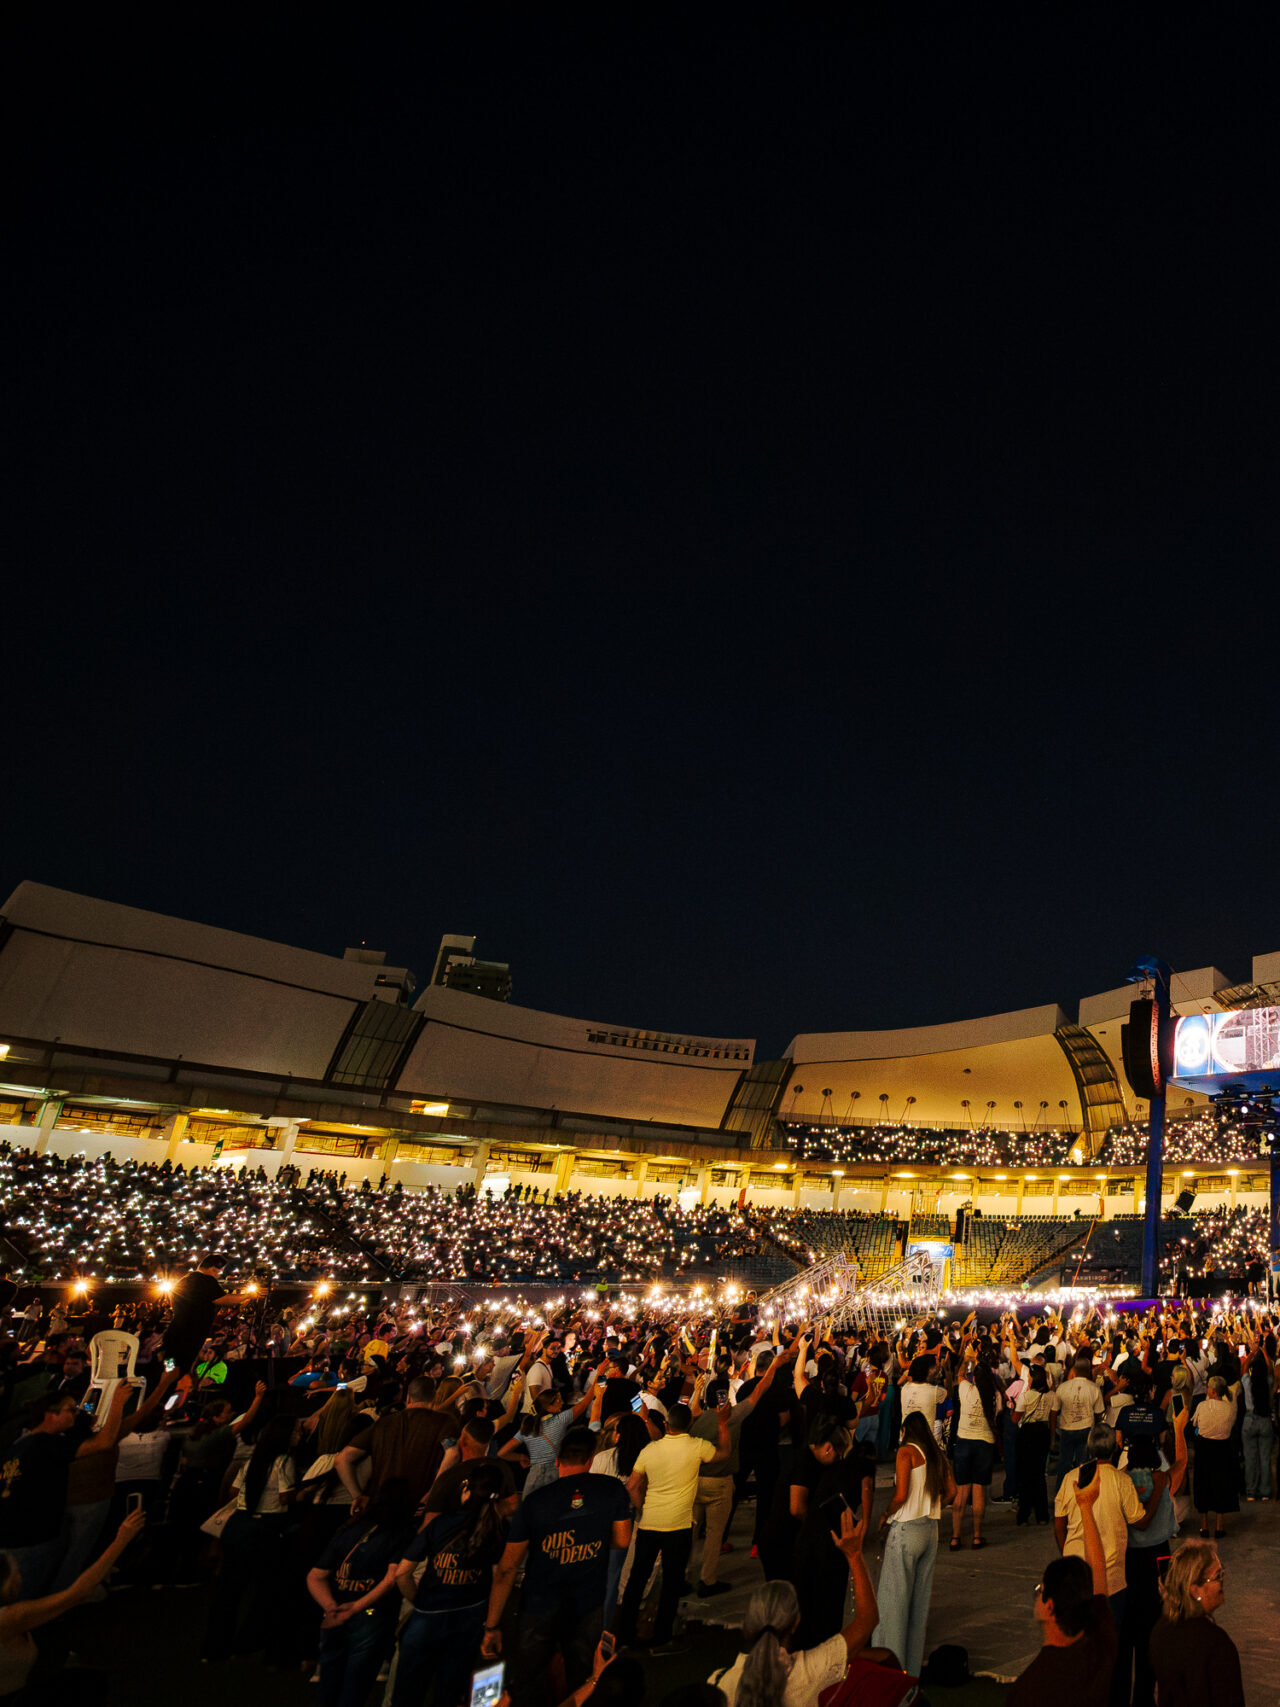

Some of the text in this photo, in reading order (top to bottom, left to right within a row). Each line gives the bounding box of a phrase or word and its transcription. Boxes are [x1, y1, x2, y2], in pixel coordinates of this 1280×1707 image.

[541, 1529, 576, 1553] QUIS
[433, 1552, 459, 1570] QUIS
[560, 1540, 603, 1565] DEUS?
[442, 1568, 483, 1585] DEUS?
